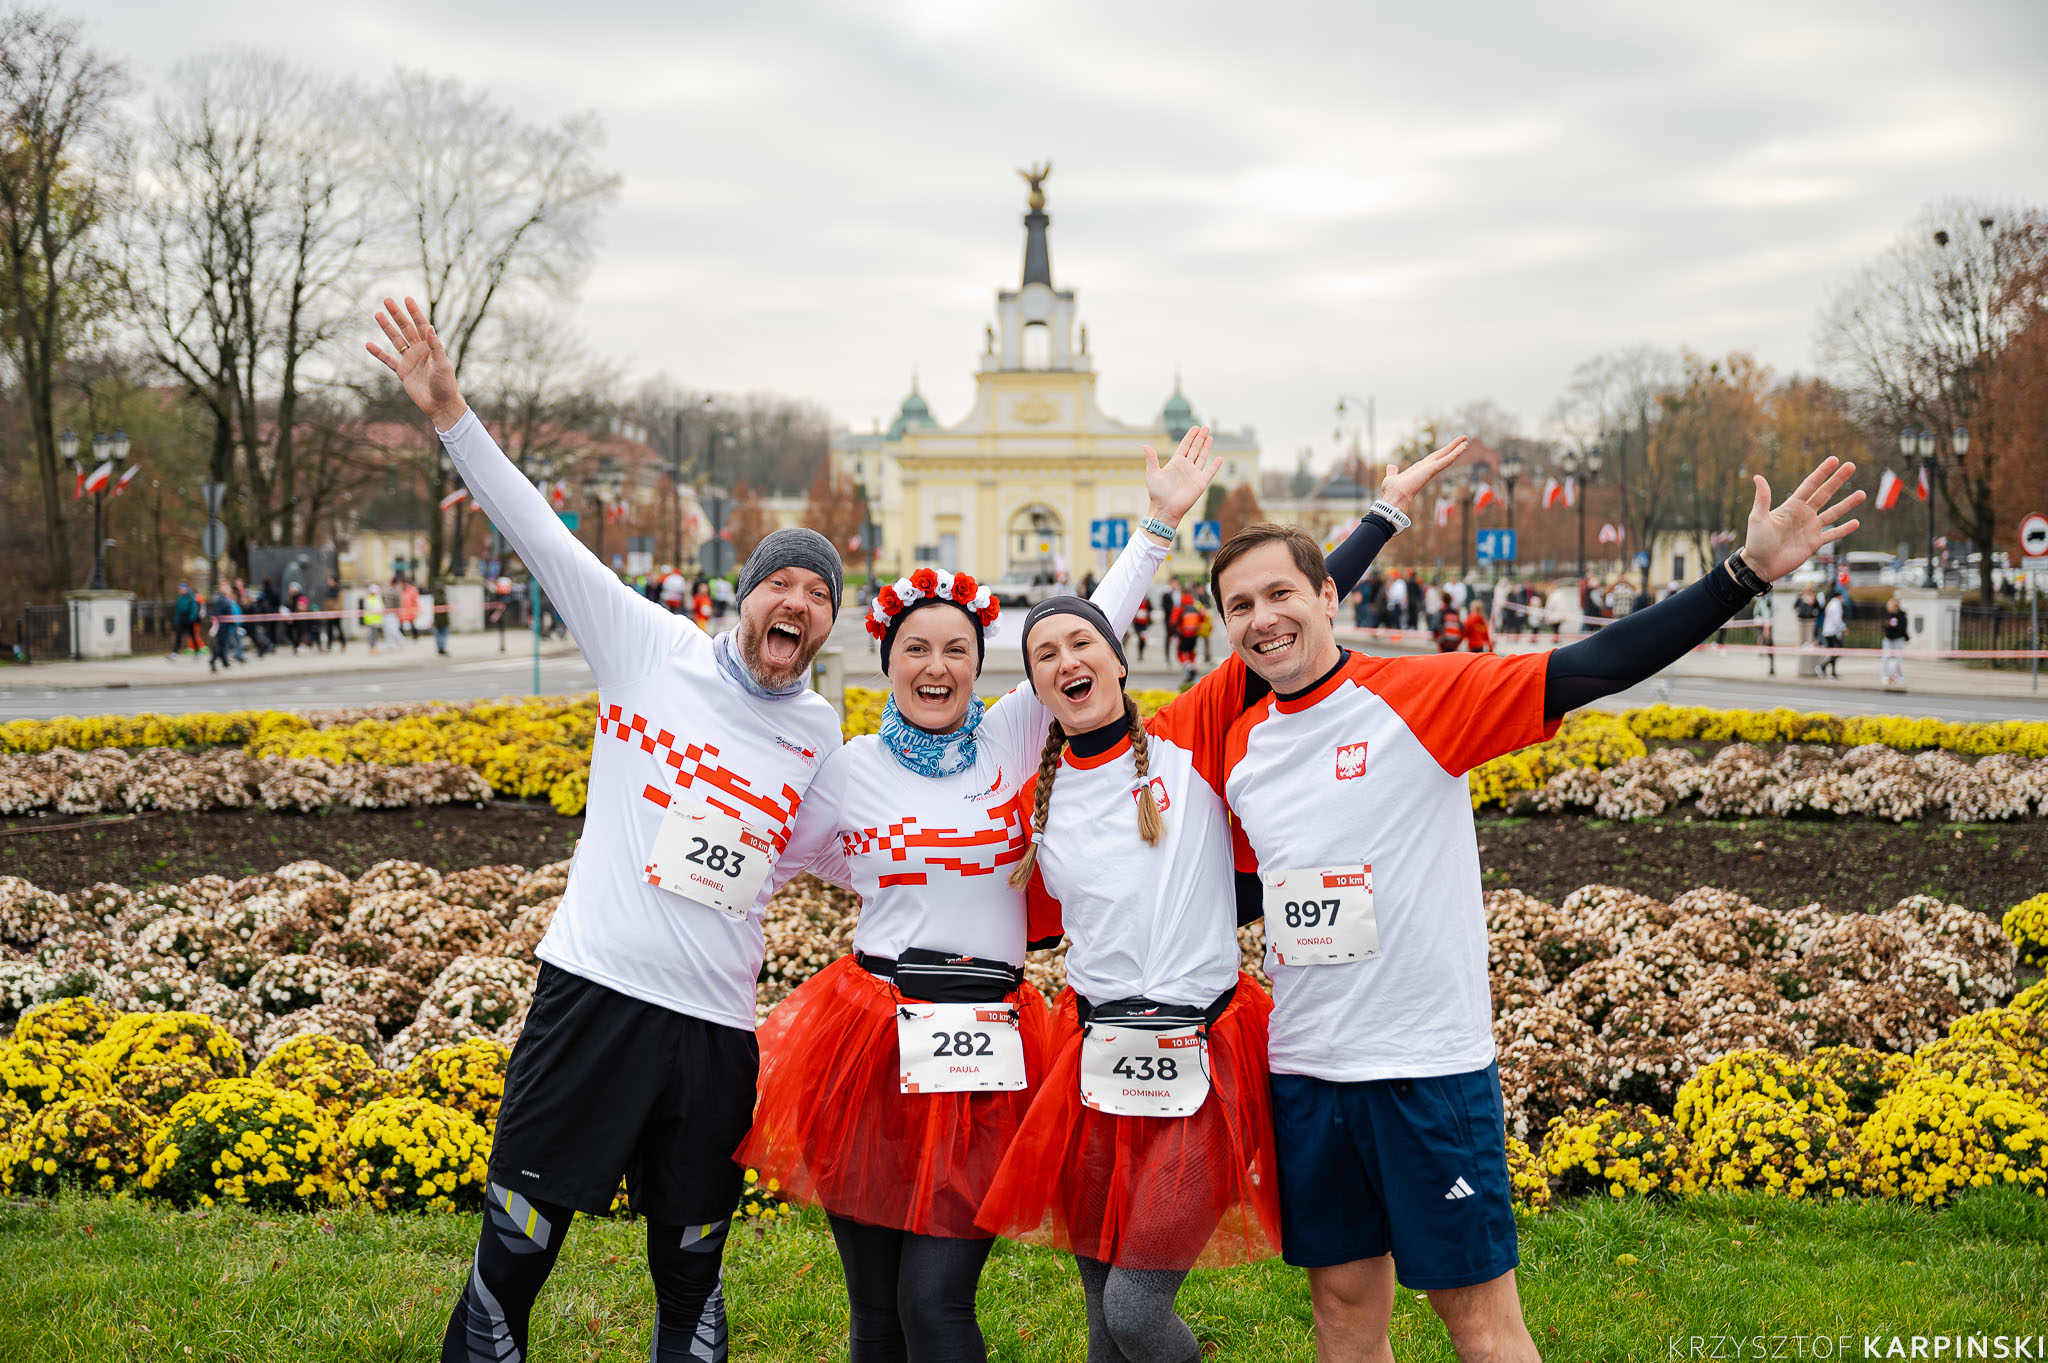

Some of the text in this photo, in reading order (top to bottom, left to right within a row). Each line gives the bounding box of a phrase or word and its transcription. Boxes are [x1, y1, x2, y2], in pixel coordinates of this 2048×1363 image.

[749, 837, 769, 852] 10 km
[685, 837, 746, 878] 283
[690, 872, 725, 892] GABRIEL
[1336, 876, 1363, 885] 10 km
[1284, 899, 1341, 928] 897
[1296, 937, 1333, 946] KONRAD
[988, 1012, 1011, 1020] 10 km
[931, 1031, 994, 1057] 282
[1172, 1038, 1198, 1047] 10 km
[1112, 1056, 1178, 1081] 438
[1122, 1088, 1171, 1098] DOMINIKA
